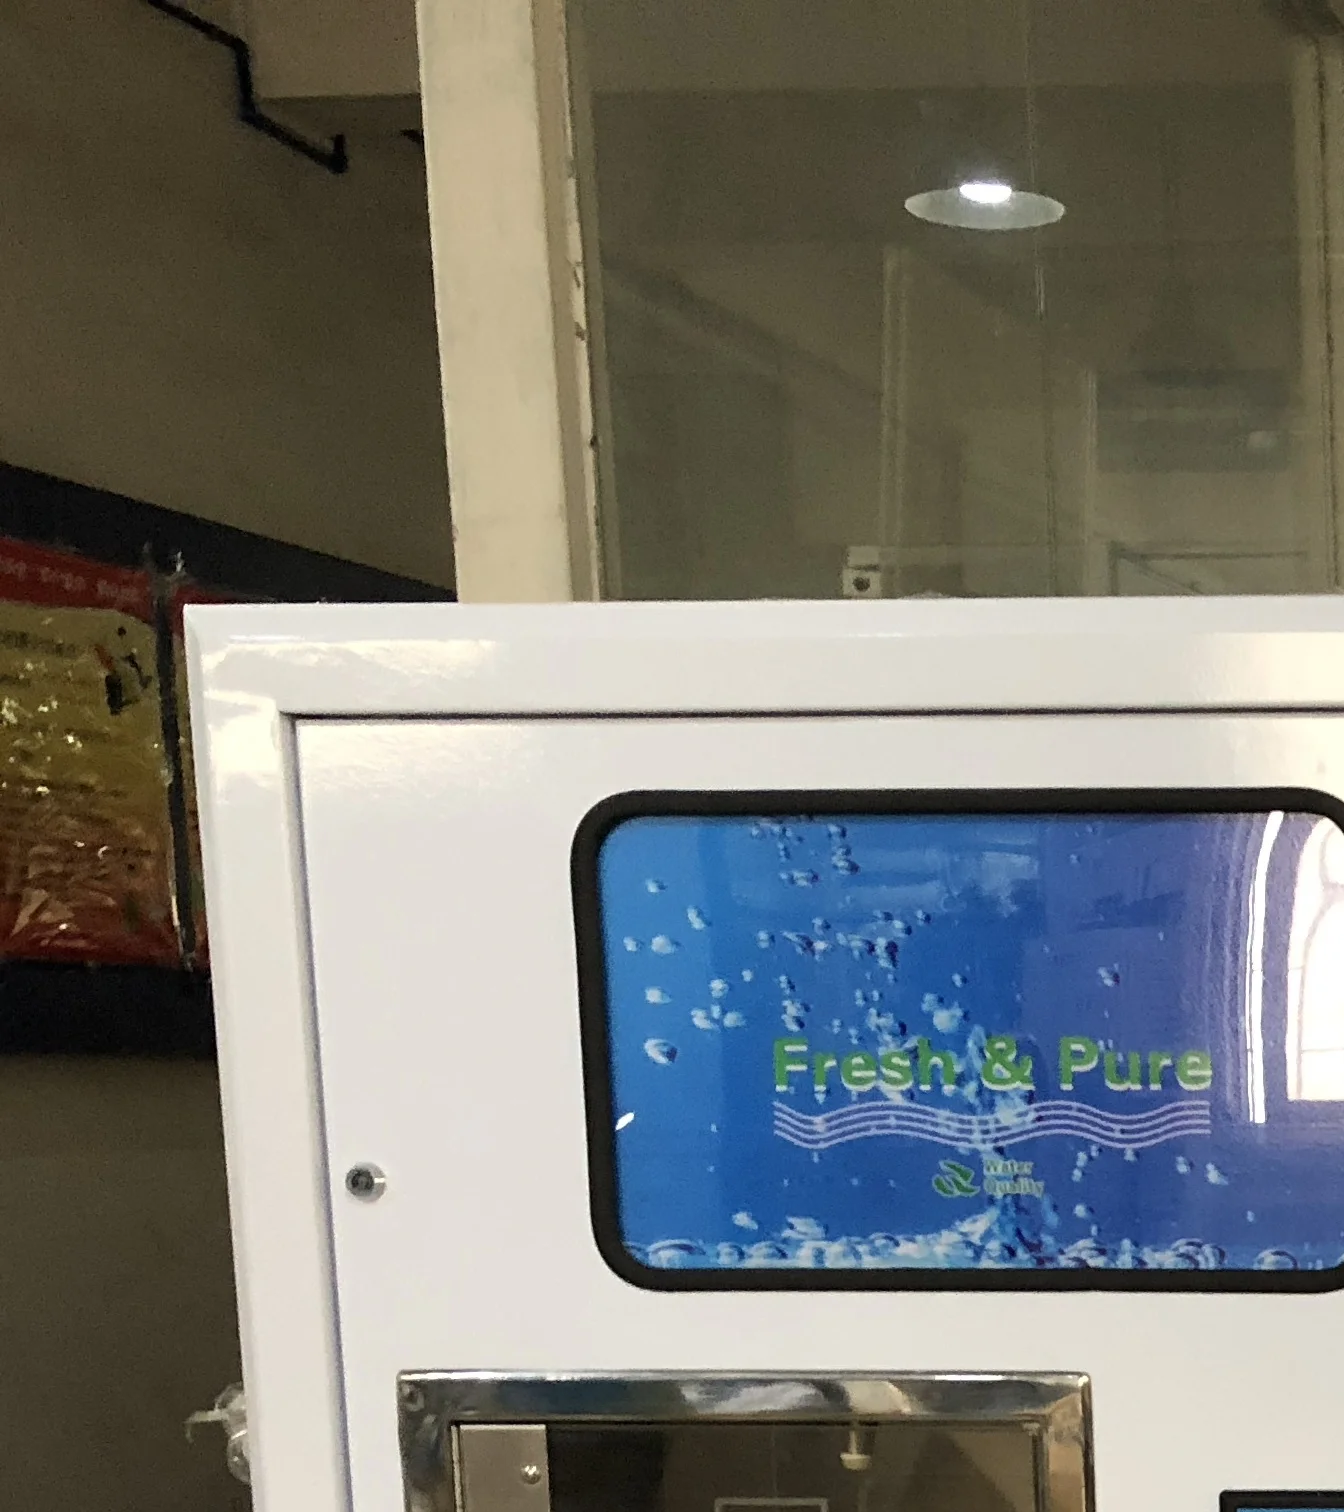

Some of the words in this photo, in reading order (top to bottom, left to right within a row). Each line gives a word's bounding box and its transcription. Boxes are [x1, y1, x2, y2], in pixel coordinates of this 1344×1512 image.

[772, 1036, 956, 1092] Fresh
[981, 1035, 1035, 1091] &
[1059, 1036, 1213, 1091] Pure
